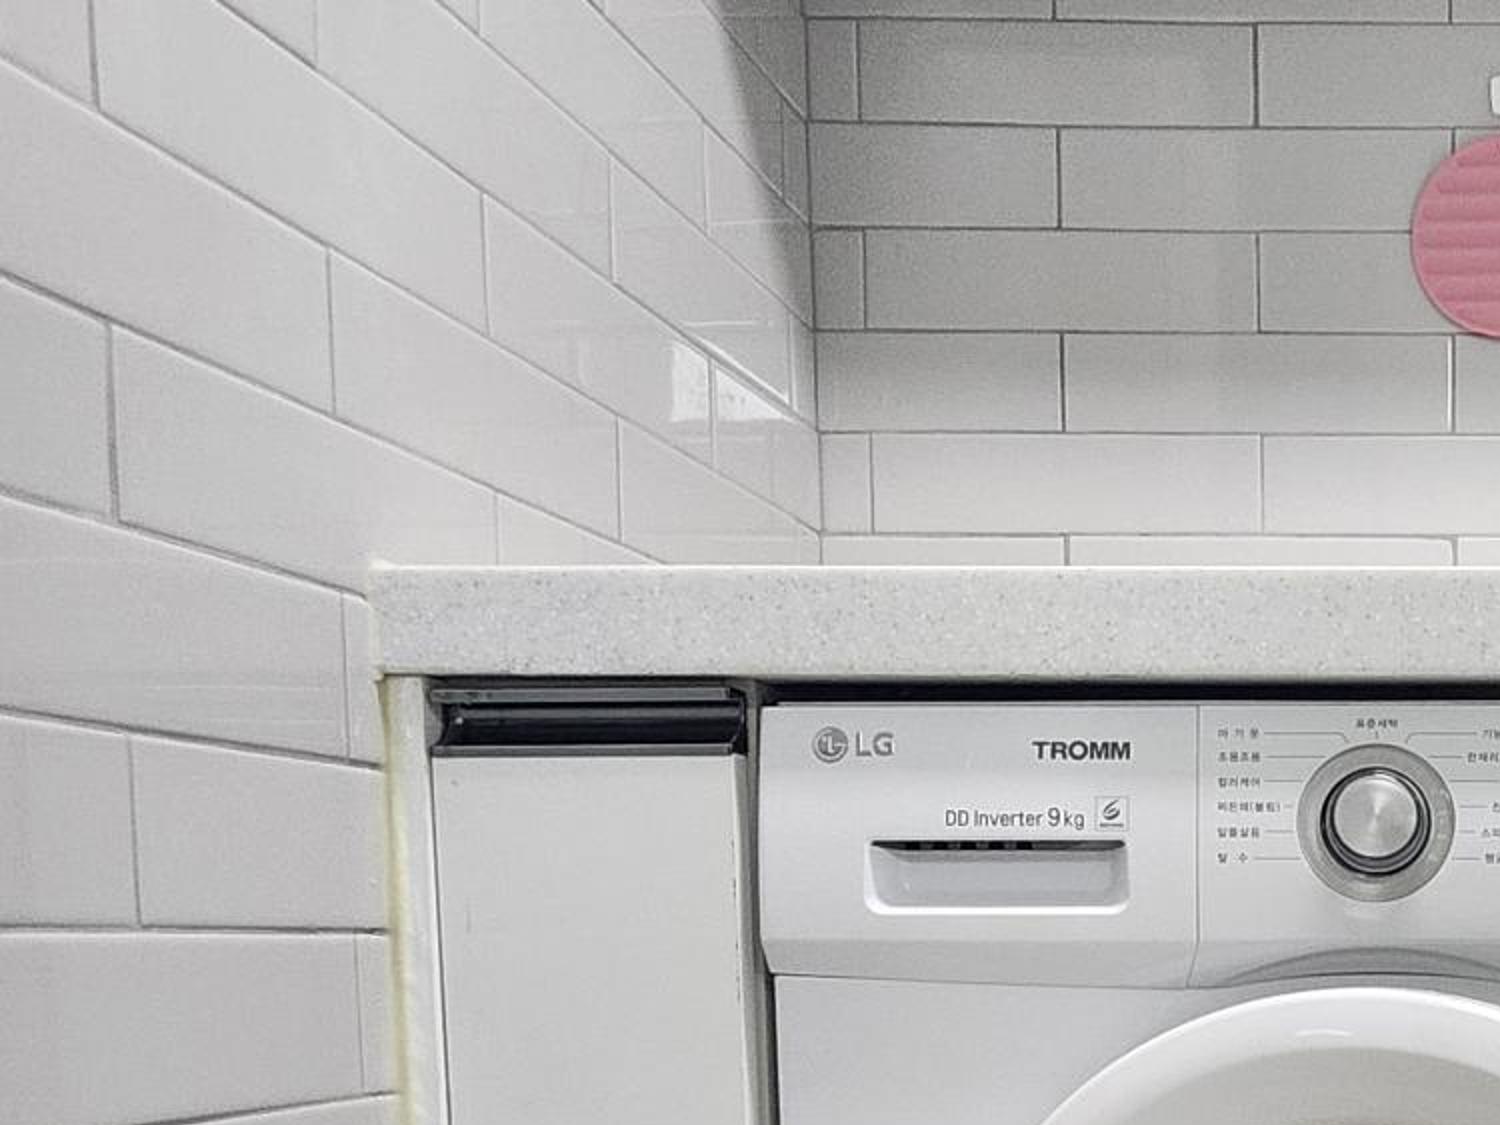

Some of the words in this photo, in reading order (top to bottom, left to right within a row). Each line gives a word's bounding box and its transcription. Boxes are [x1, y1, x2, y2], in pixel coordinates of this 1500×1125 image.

[855, 732, 895, 757] LG
[1032, 740, 1132, 761] TROMM
[944, 809, 970, 828] DD
[973, 809, 1043, 828] Inverter
